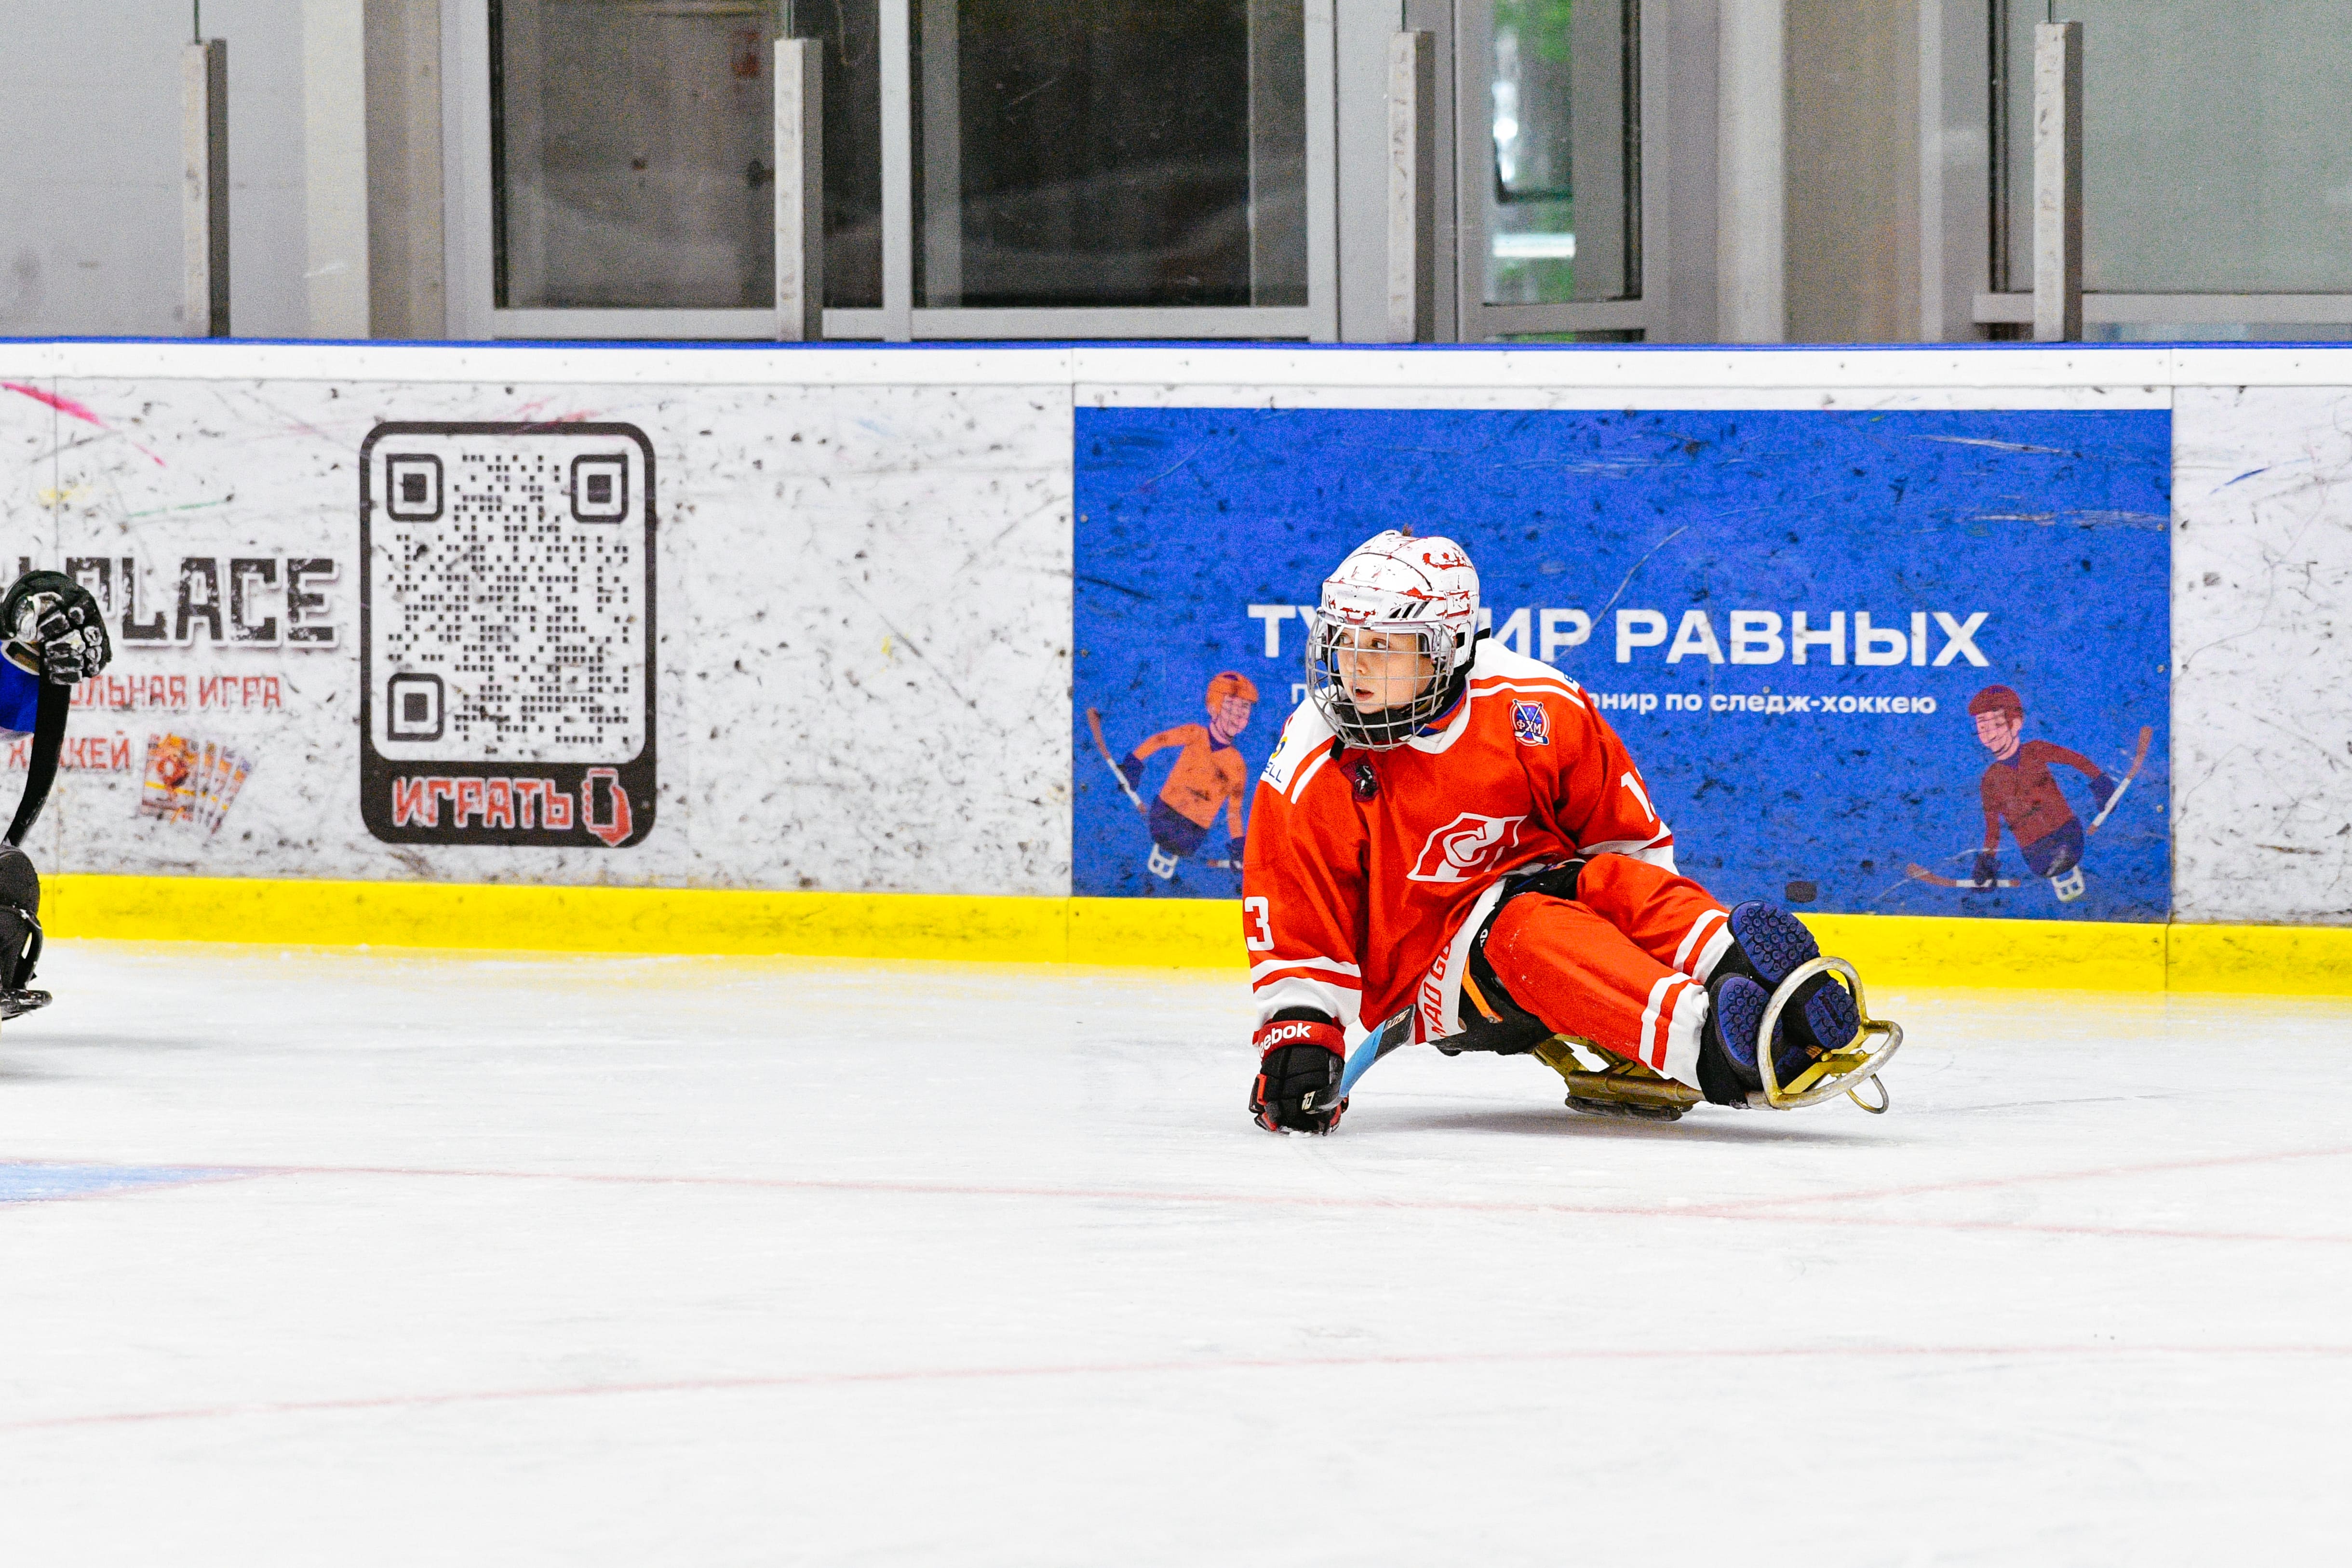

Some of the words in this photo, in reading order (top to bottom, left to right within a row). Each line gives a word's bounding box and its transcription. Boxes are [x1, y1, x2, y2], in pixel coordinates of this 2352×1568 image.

[1615, 609, 1989, 667] РАВНЫХ
[199, 676, 282, 707] ИГРА
[1666, 694, 1703, 711] по
[1710, 694, 1936, 714] следж-хоккею
[9, 730, 131, 769] ХКЕЙ
[1516, 719, 1542, 735] ФХМ
[393, 777, 573, 828] ИГРАТЬ
[1620, 767, 1656, 823] 1
[1244, 896, 1275, 952] 3
